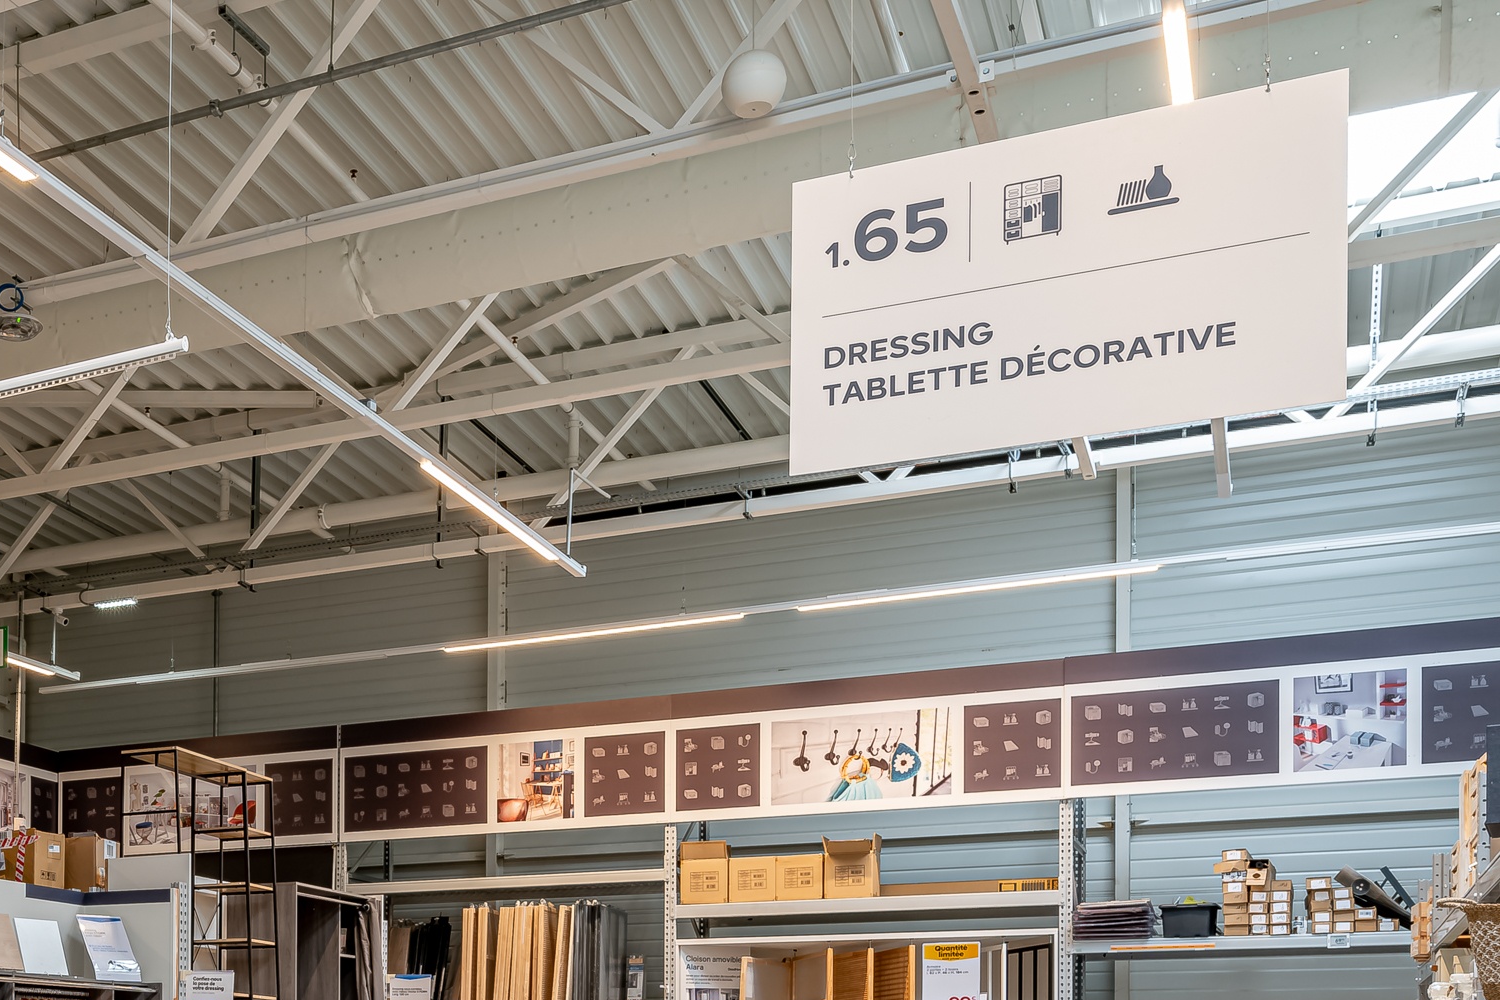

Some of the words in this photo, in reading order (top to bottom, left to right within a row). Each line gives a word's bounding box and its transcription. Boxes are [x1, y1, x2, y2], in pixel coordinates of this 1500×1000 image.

[825, 197, 949, 269] 1.65
[822, 360, 989, 407] TABLETTE
[1000, 321, 1237, 382] DÉCORATIVE
[823, 321, 994, 370] DRESSING
[685, 955, 711, 963] Cloison
[686, 963, 704, 971] Alara
